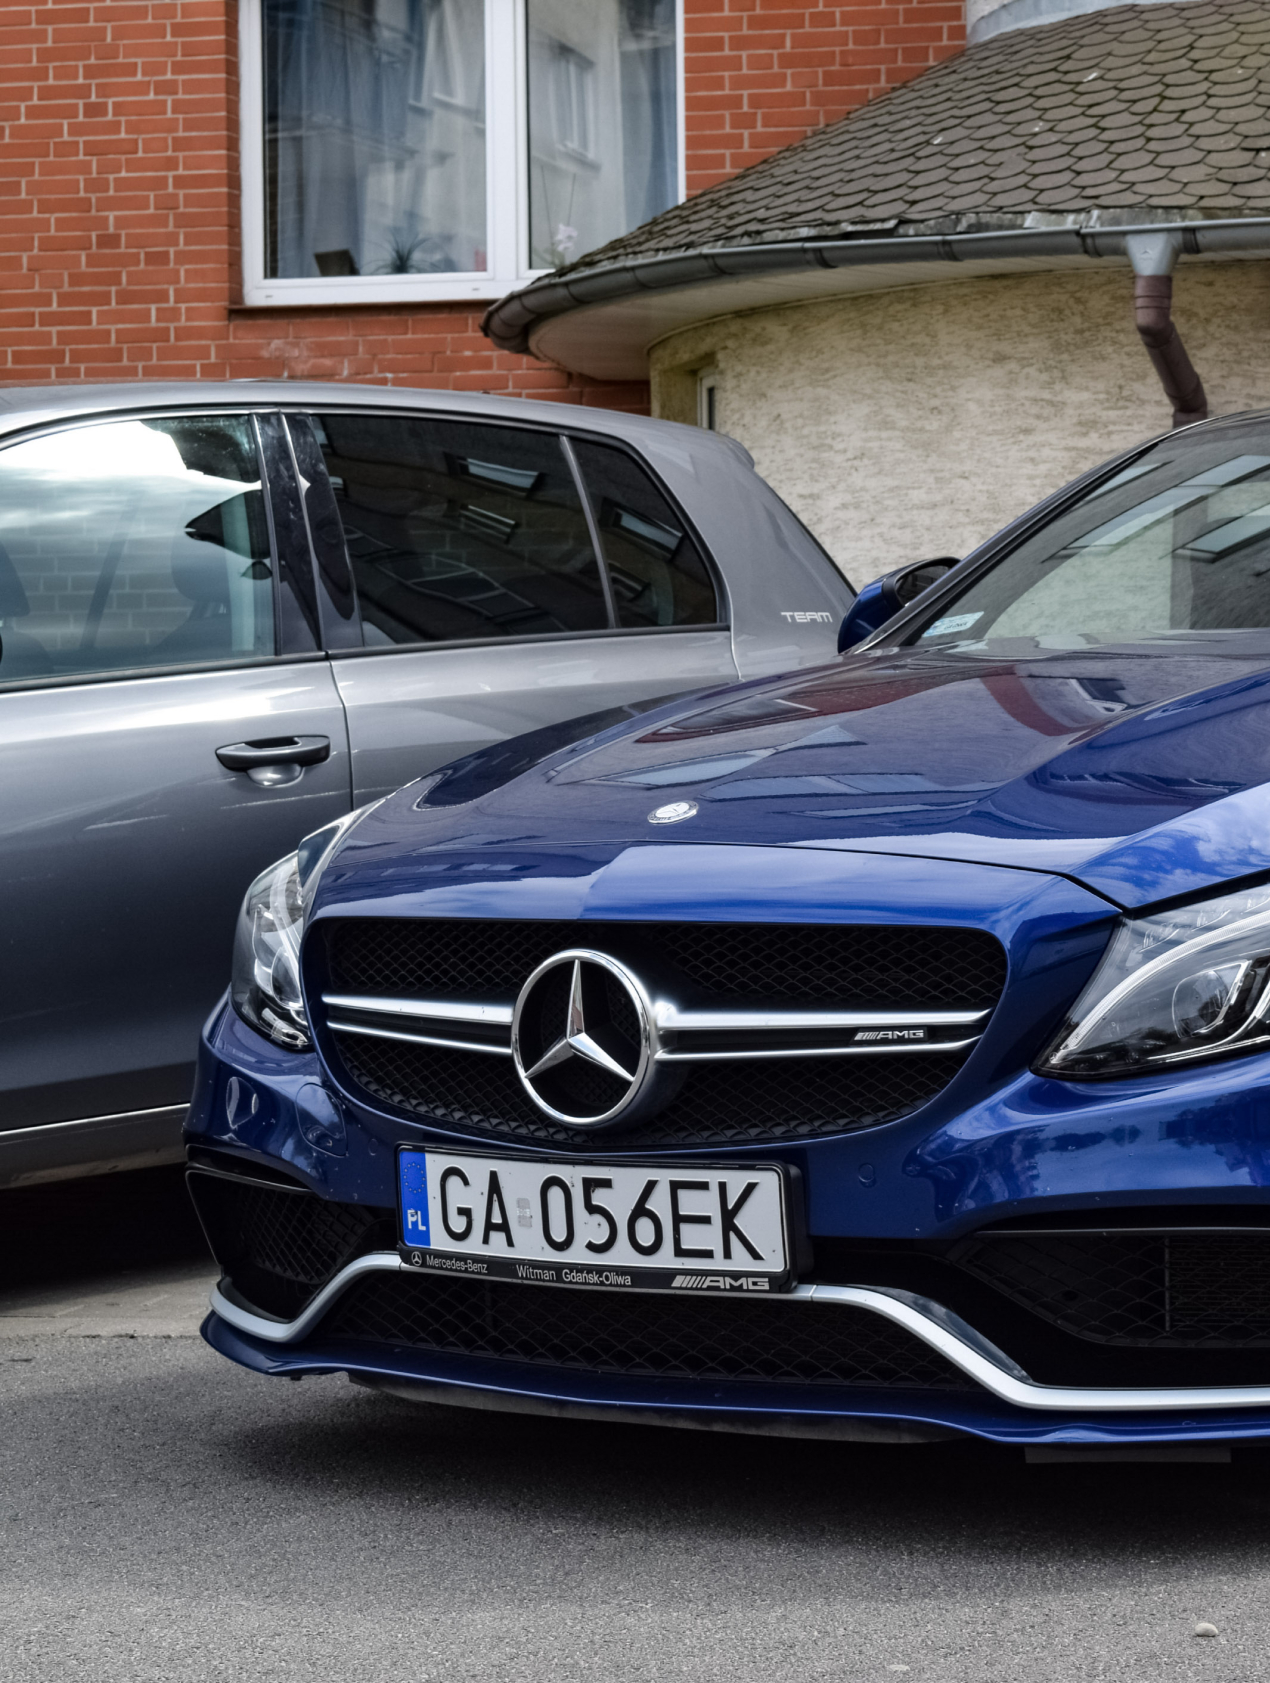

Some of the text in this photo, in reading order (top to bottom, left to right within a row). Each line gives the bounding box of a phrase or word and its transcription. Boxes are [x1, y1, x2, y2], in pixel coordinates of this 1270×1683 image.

[781, 611, 833, 623] TEAM
[876, 1029, 924, 1040] AMG
[407, 1209, 427, 1232] PL
[439, 1165, 766, 1261] GA 056EK
[426, 1254, 488, 1274] Mercedes-Benz
[516, 1264, 632, 1286] Witman Gdańsk-Oliwa
[702, 1276, 770, 1290] AMG
